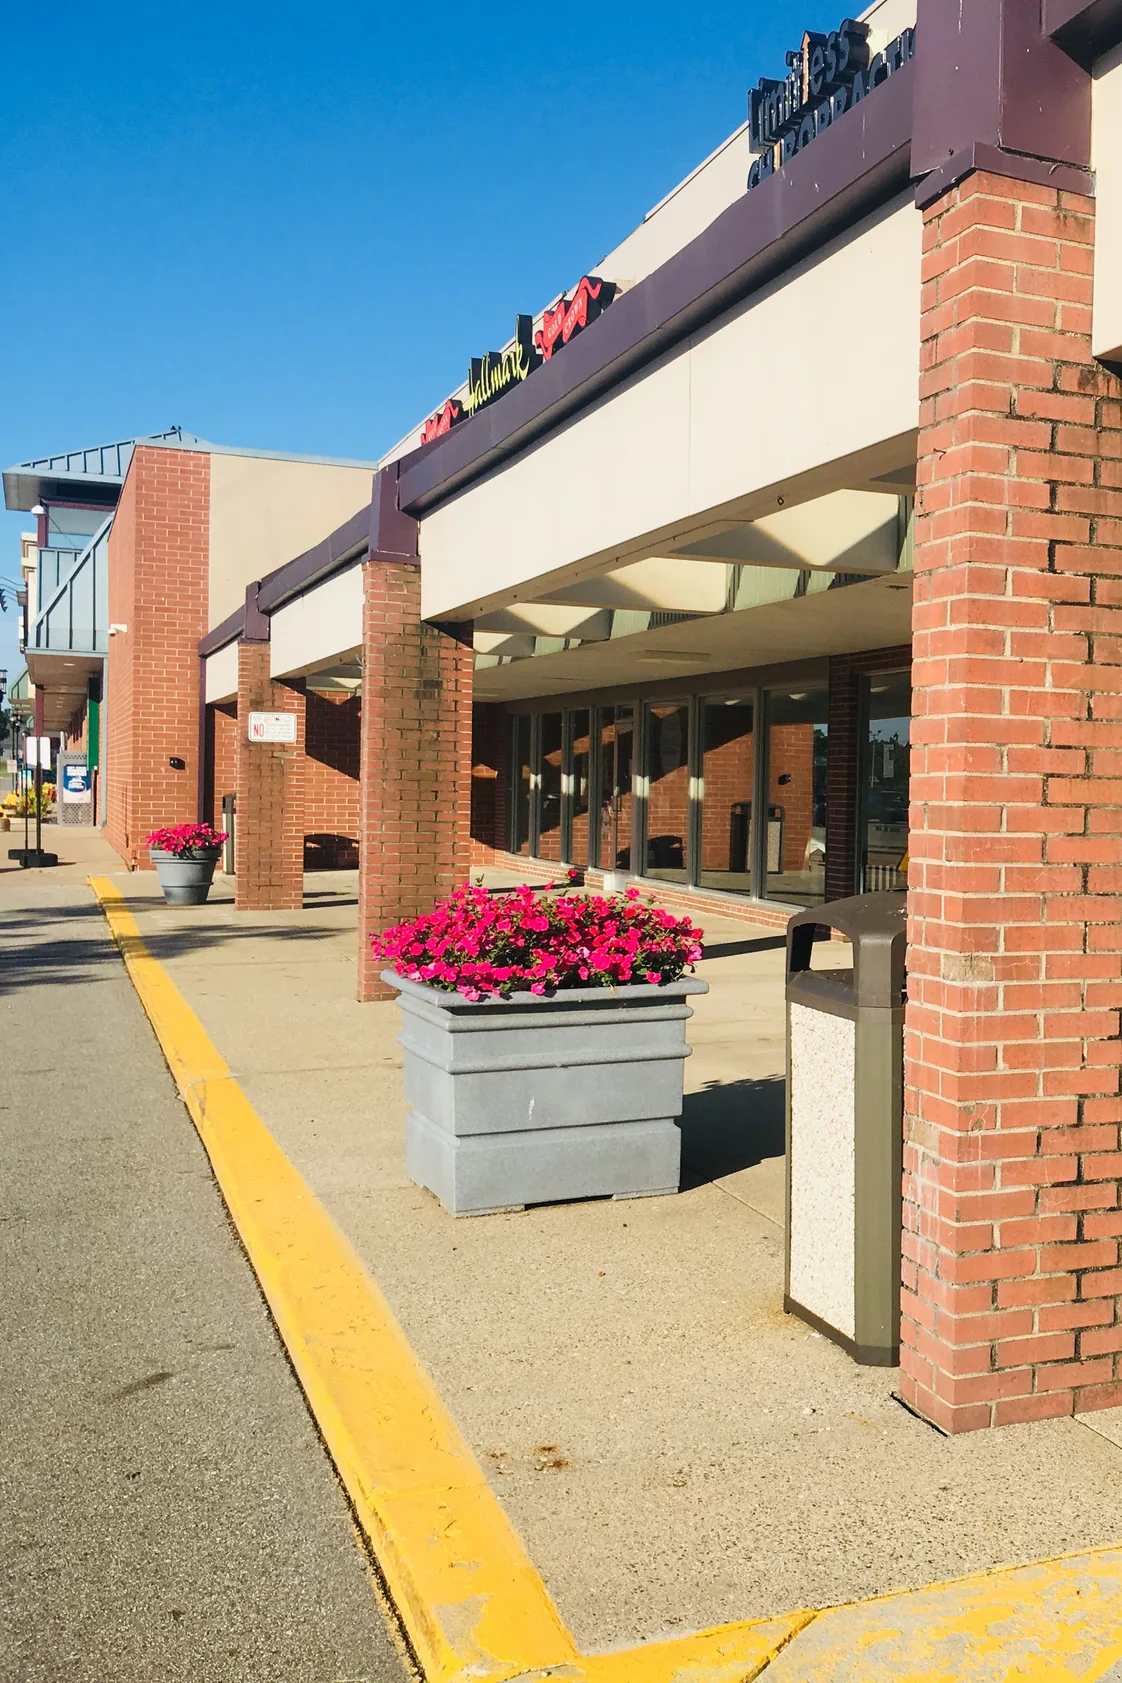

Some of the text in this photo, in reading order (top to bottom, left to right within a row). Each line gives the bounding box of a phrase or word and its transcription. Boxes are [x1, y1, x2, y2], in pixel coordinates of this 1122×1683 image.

[747, 26, 917, 192] CHIROPRACTI
[547, 296, 583, 339] GOLD CROWN
[461, 314, 532, 417] Hallmark
[253, 723, 265, 738] NO
